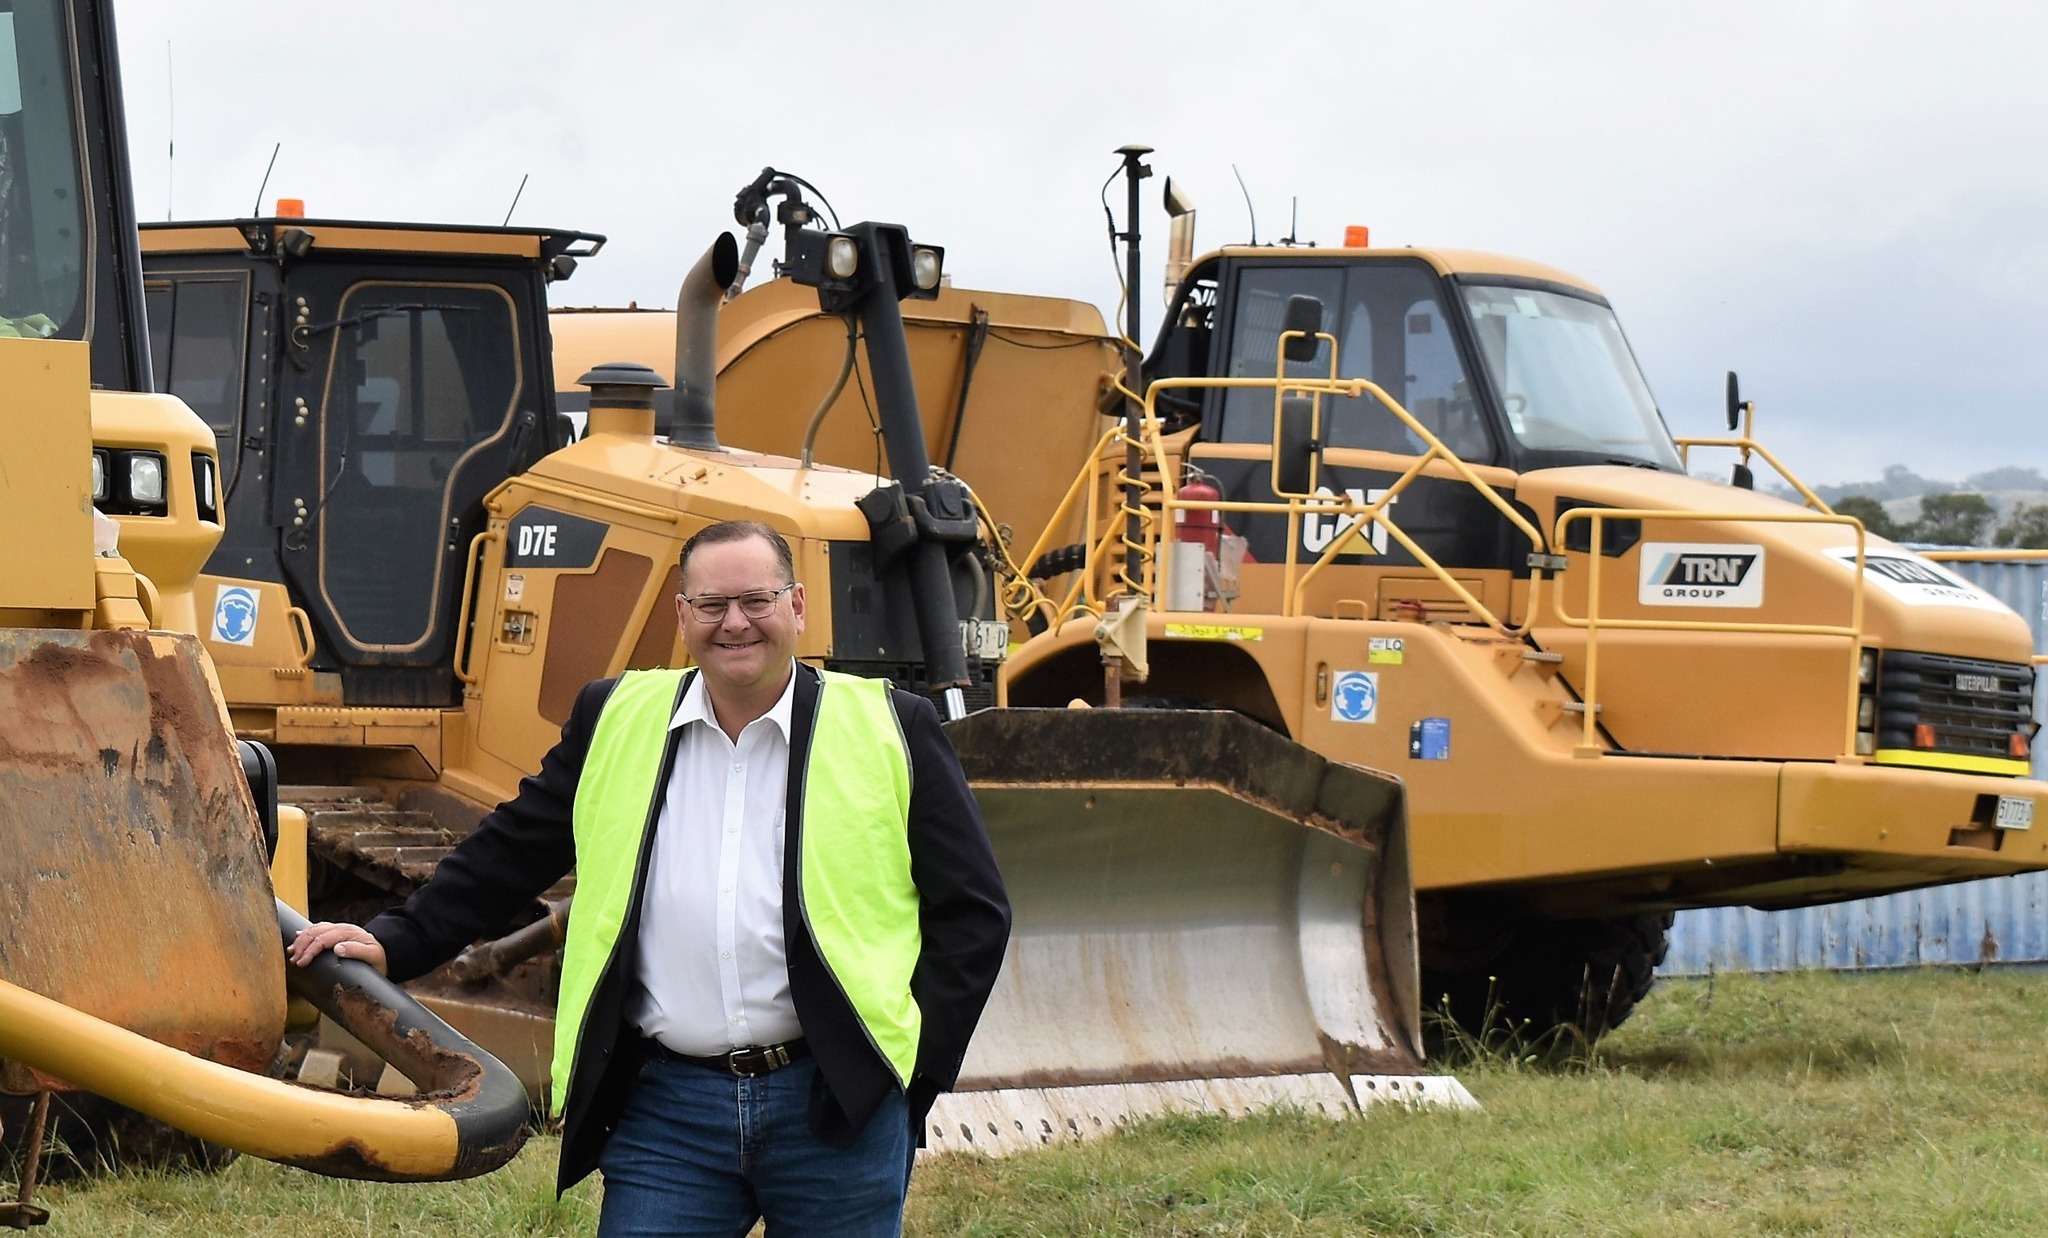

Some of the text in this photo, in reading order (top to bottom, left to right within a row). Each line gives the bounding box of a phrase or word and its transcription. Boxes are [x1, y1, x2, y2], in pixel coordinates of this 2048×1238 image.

[1303, 486, 1398, 555] CAT
[518, 525, 558, 556] D7E
[1681, 557, 1742, 583] TRN
[1663, 588, 1725, 598] GROUP
